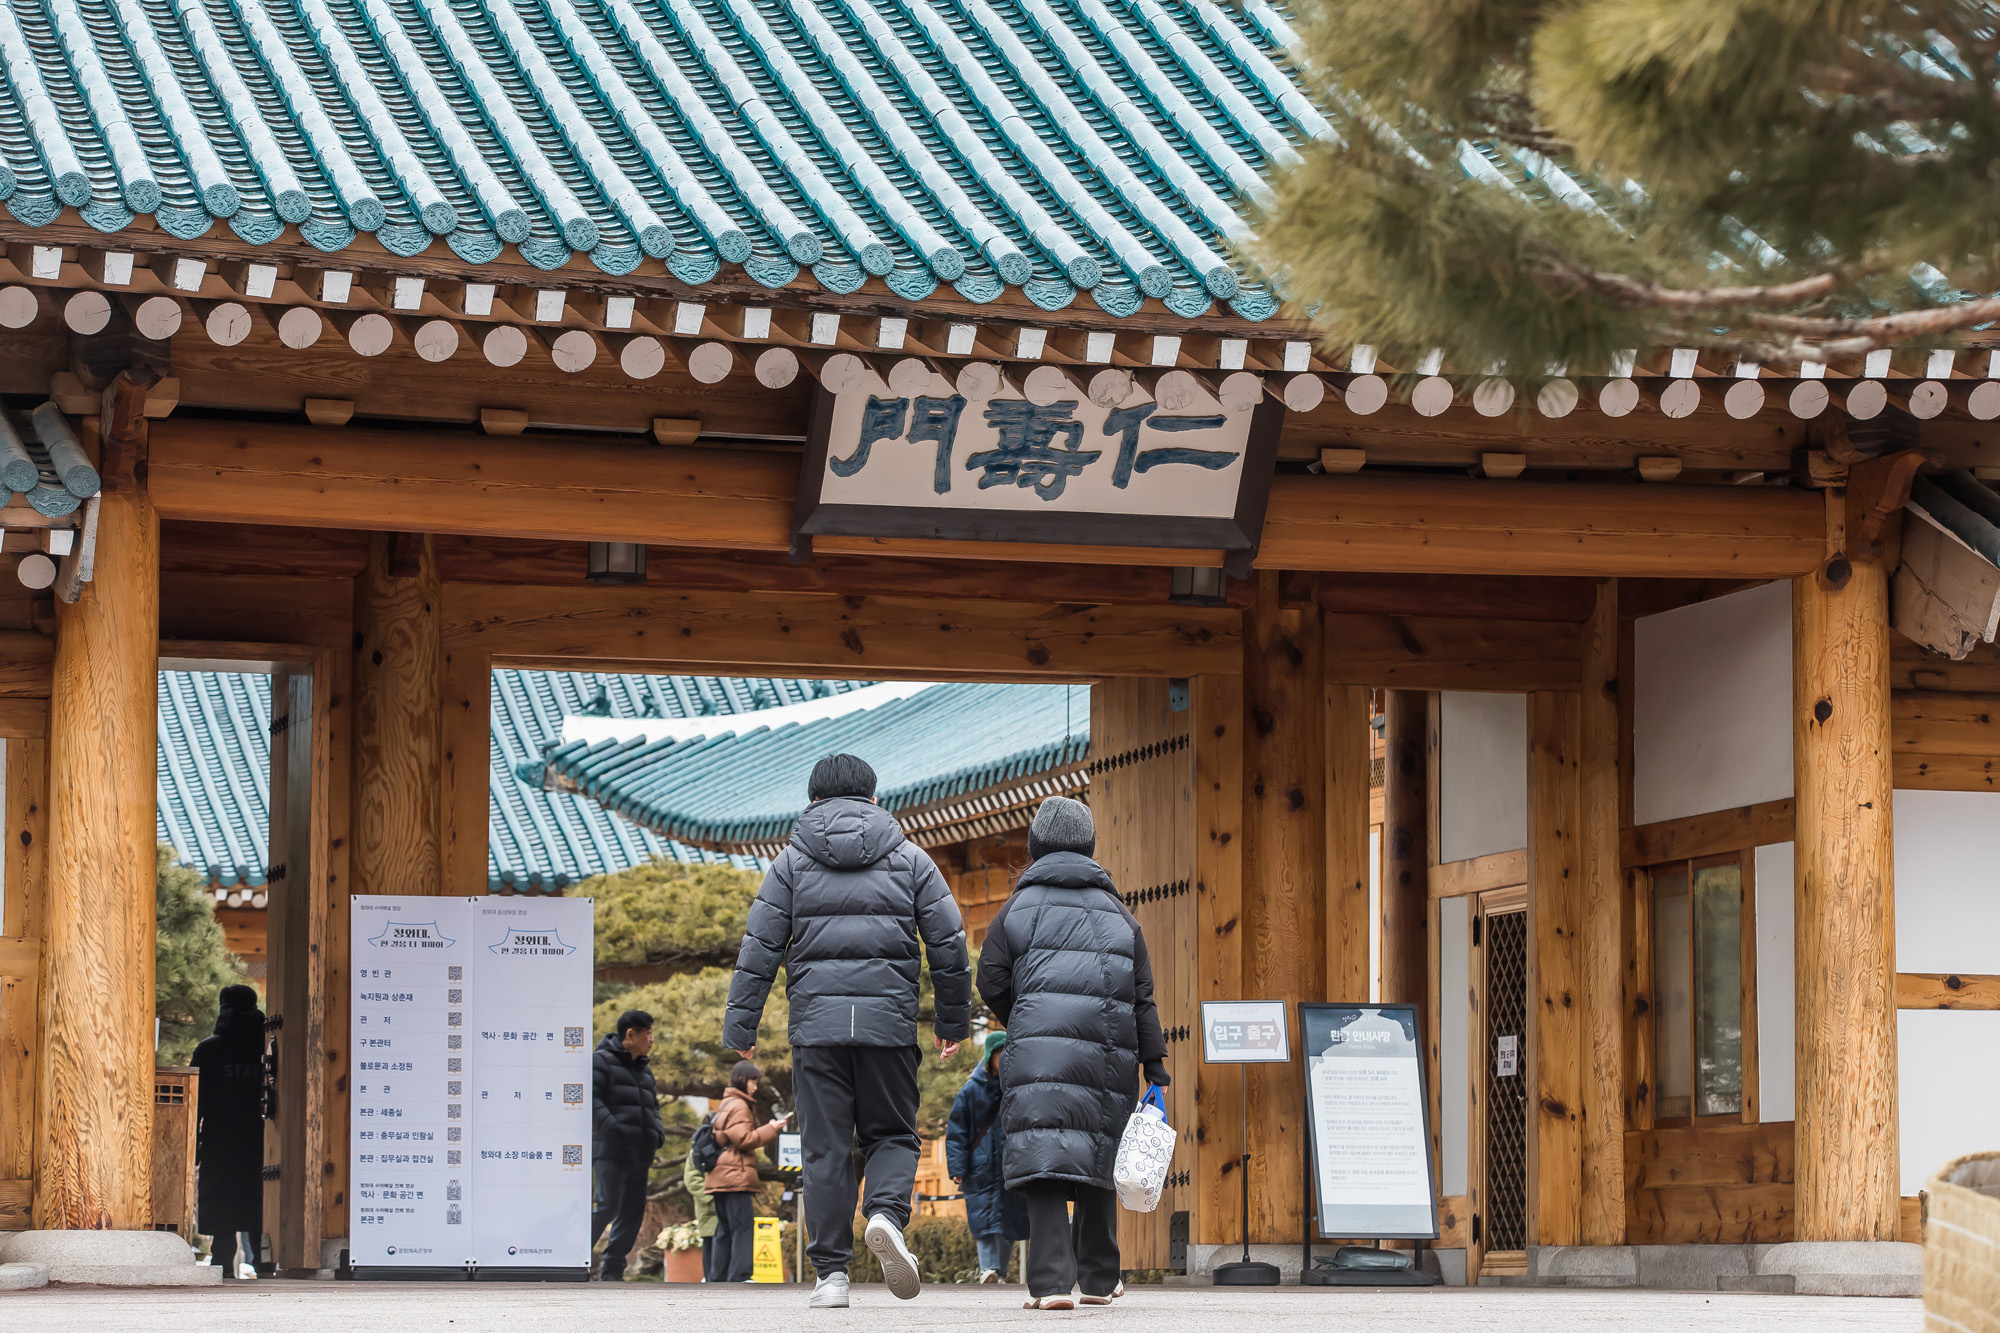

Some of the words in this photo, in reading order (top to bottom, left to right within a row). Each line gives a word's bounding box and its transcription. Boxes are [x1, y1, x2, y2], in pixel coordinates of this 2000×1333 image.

[393, 928, 430, 939] 청와대,
[514, 936, 551, 946] 청와대,
[360, 993, 389, 1001] 녹지원과
[392, 993, 413, 1001] 상춘재
[522, 1032, 537, 1040] 공간
[547, 1032, 553, 1041] 편
[1214, 1025, 1242, 1040] 입구
[1247, 1025, 1275, 1040] 출구
[1353, 1031, 1391, 1042] 안내사항
[360, 1039, 367, 1047] 구
[369, 1039, 391, 1047] 본관터
[360, 1062, 389, 1070] 불로문과
[391, 1062, 413, 1071] 소정원
[545, 1092, 552, 1100] 편
[360, 1108, 374, 1116] 본관
[381, 1108, 402, 1117] 세종실
[360, 1131, 374, 1140] 본관
[381, 1131, 409, 1140] 충무실과
[412, 1132, 434, 1140] 인왕실
[360, 1154, 374, 1163] 본관
[381, 1155, 409, 1163] 집무실과
[412, 1155, 434, 1163] 접견실
[481, 1151, 501, 1159] 청와대
[504, 1151, 518, 1159] 소장
[522, 1151, 543, 1160] 미술품
[546, 1151, 552, 1160] 편
[399, 1191, 414, 1199] 공간
[416, 1191, 424, 1199] 편
[360, 1216, 374, 1224] 본관
[377, 1216, 384, 1224] 편
